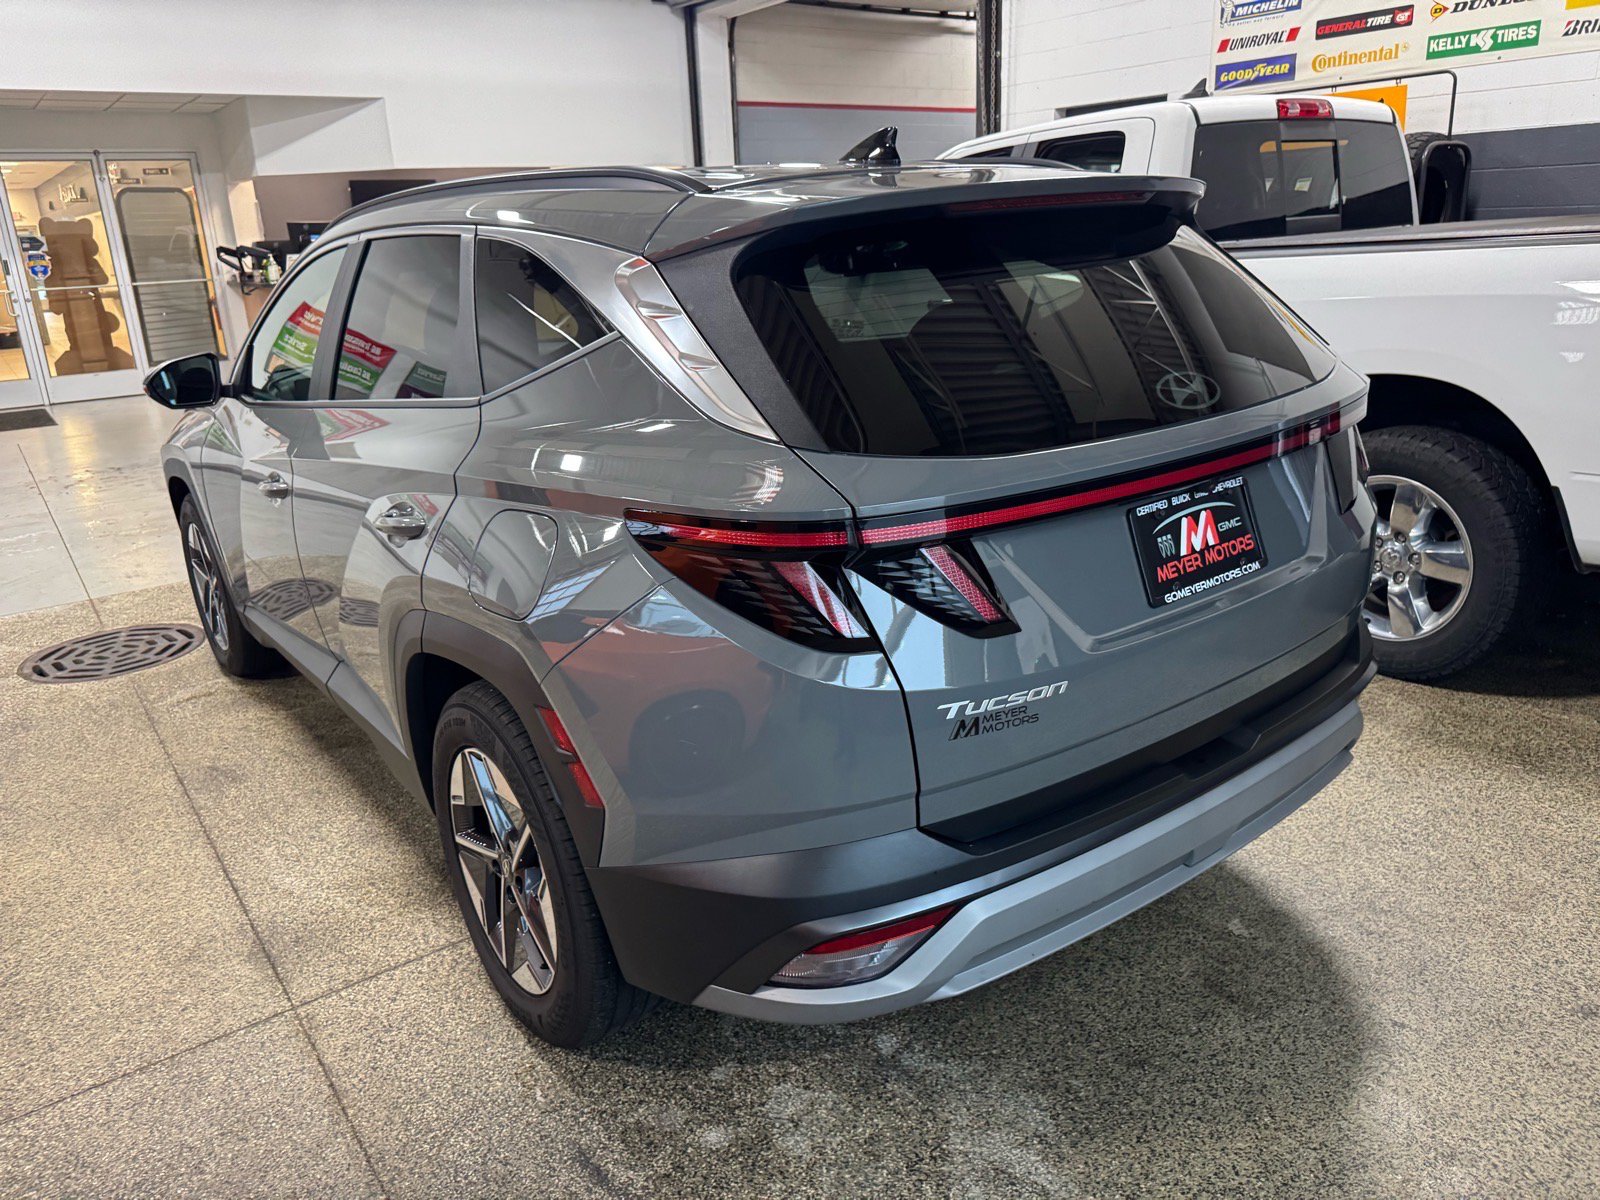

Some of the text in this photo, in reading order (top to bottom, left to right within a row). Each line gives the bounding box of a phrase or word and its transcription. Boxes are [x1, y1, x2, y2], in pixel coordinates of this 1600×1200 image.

[1235, 0, 1299, 17] MICHELIN
[1450, 0, 1533, 13] DUN
[1561, 18, 1600, 37] BRI
[1229, 30, 1285, 51] UNIROYAL
[1429, 34, 1470, 53] KELLY
[1496, 25, 1538, 43] TIRES
[1311, 43, 1400, 73] Continental
[1220, 63, 1290, 82] GOODYEAR
[1136, 499, 1169, 517] CERTIFIED
[1171, 493, 1191, 506] BUICK
[1179, 509, 1220, 557] M
[1217, 516, 1243, 532] GMC
[1156, 533, 1255, 583] MEYER MOTORS
[1164, 561, 1261, 603] GOMEYERMOTORS.COM
[981, 713, 1040, 735] MOTORS
[982, 706, 1028, 724] MEYER
